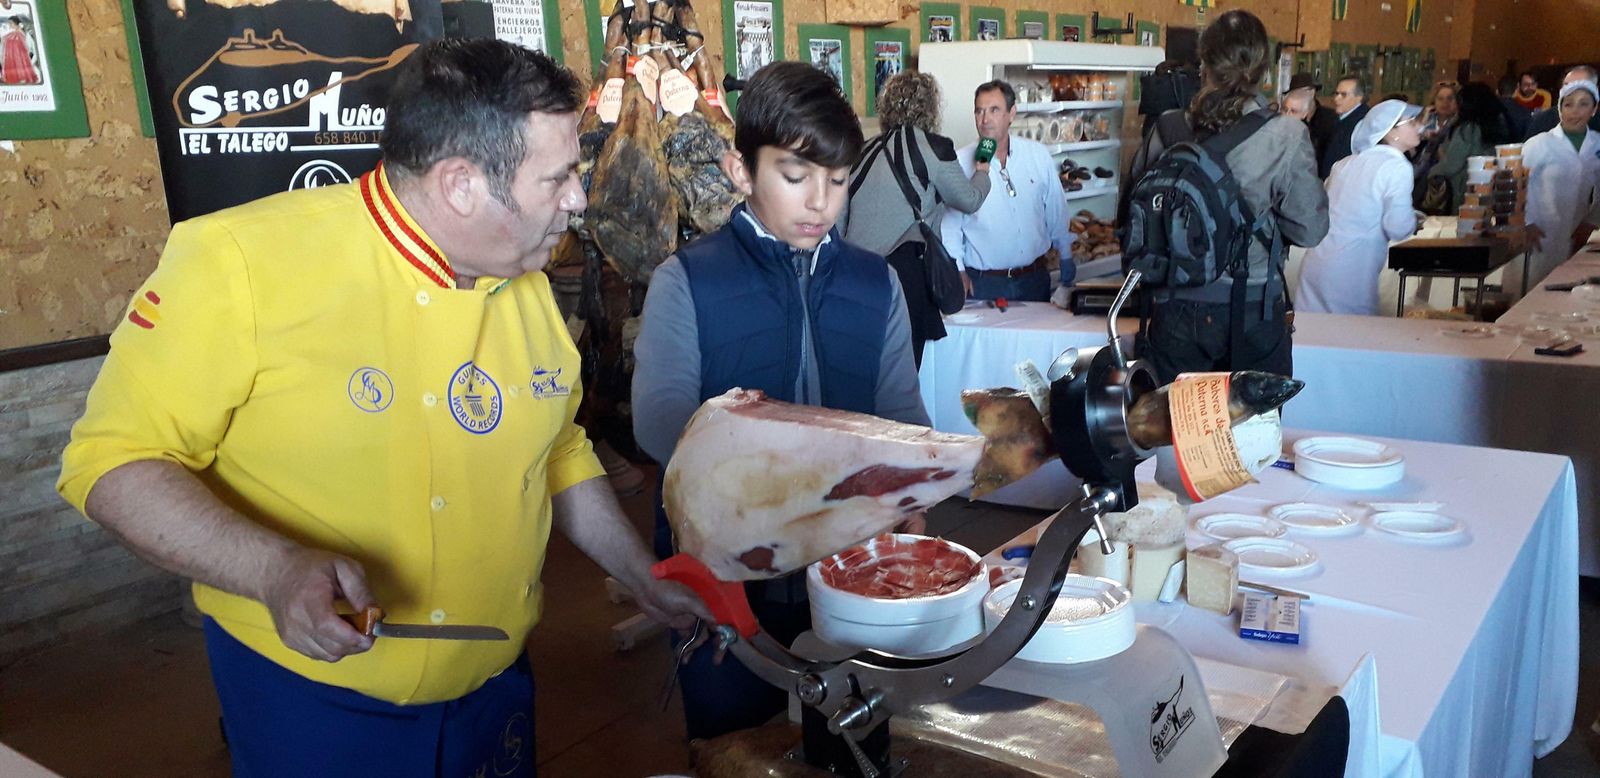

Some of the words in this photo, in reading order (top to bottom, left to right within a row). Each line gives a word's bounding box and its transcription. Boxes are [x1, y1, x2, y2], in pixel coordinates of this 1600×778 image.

[496, 26, 542, 35] CALLEJEROS
[497, 17, 540, 26] ENCIERROS
[309, 71, 388, 132] MUÑO
[188, 134, 211, 154] EL
[217, 132, 289, 154] TALEGO
[314, 132, 339, 145] 658
[343, 131, 367, 144] 840
[453, 396, 476, 428] WORLD
[478, 396, 498, 430] RECORDS
